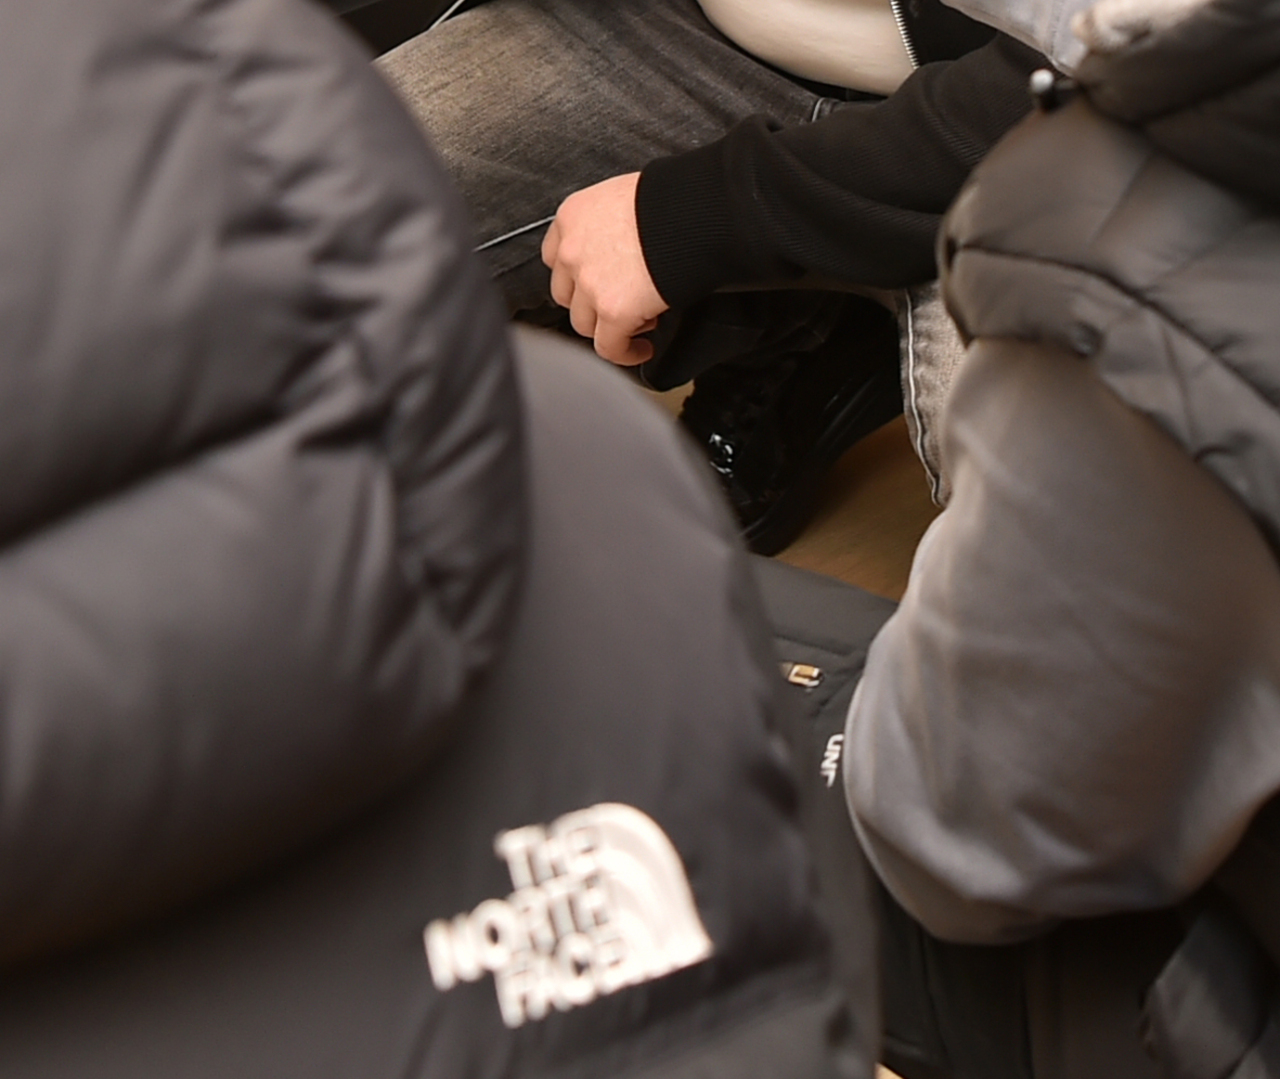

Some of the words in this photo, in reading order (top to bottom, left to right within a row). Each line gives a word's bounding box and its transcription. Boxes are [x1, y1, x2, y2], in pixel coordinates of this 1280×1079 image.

[495, 824, 602, 892] THE
[423, 874, 612, 992] NORTH
[495, 931, 630, 1029] FACE
